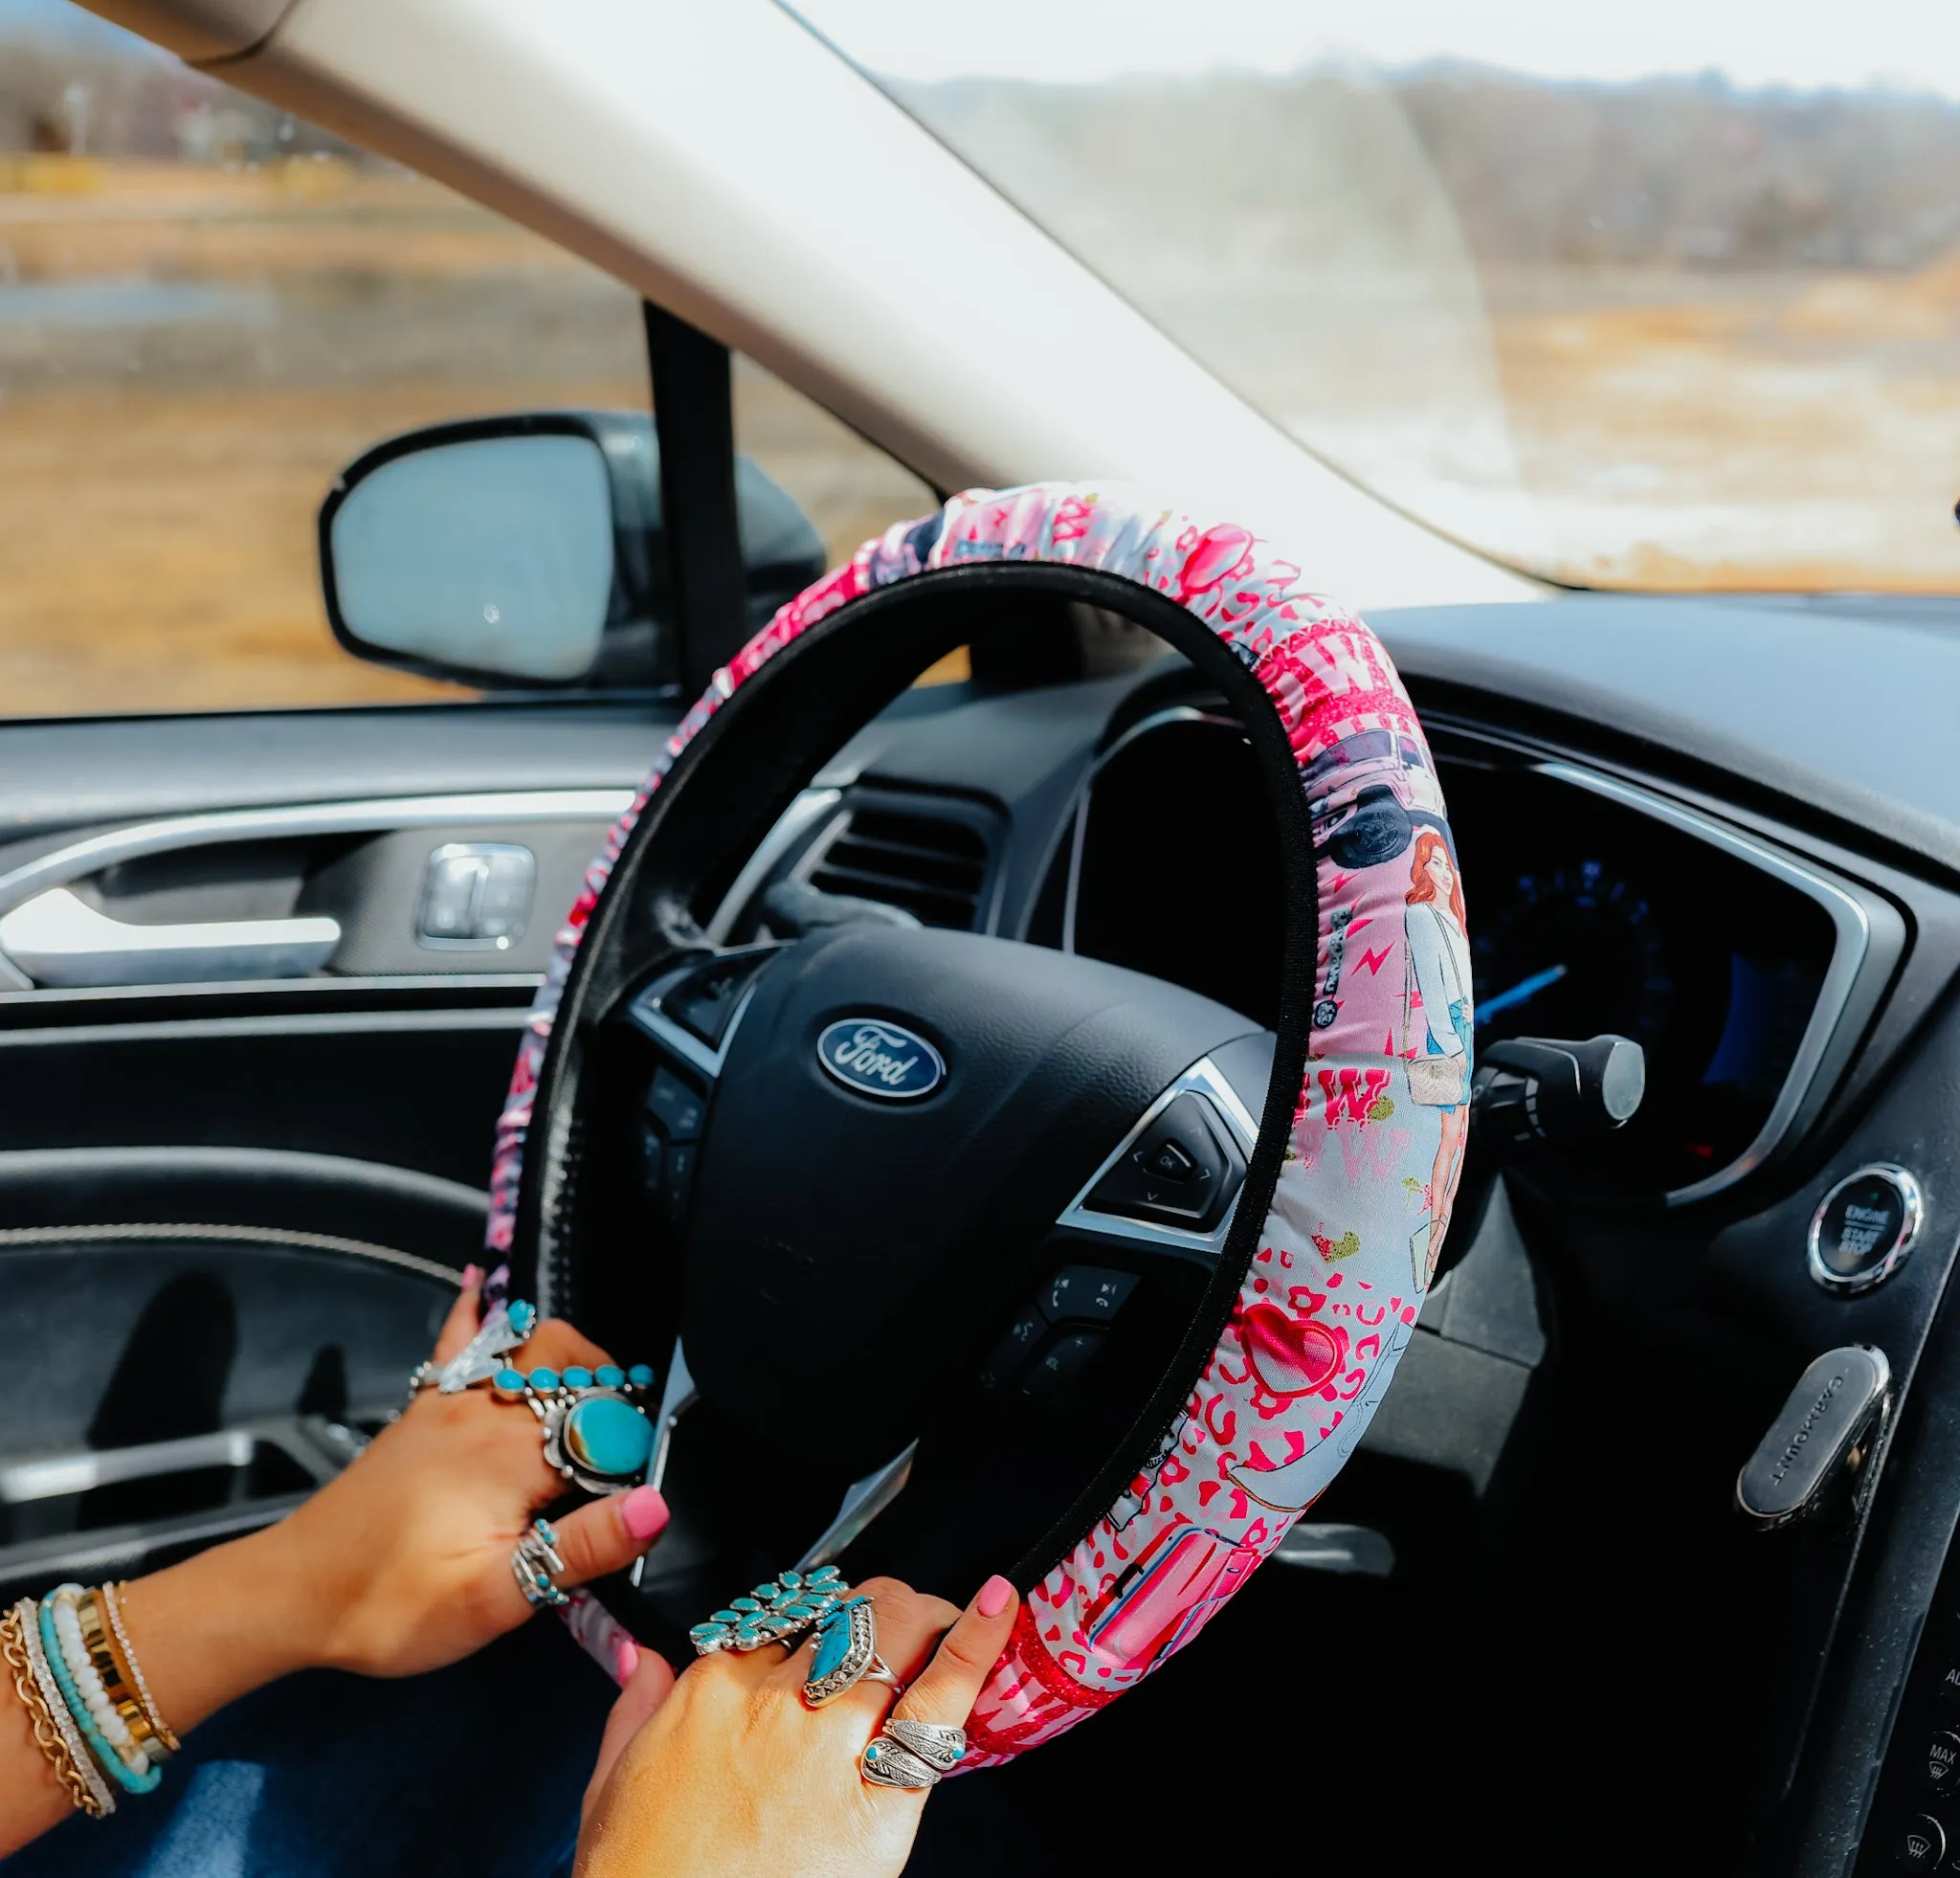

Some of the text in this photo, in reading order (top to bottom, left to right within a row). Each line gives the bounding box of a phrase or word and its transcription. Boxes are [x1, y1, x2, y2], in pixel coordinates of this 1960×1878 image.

[835, 1025, 919, 1085] Ford
[1771, 1375, 1844, 1487] CARMOUNT
[1928, 1744, 1957, 1765] MAX
